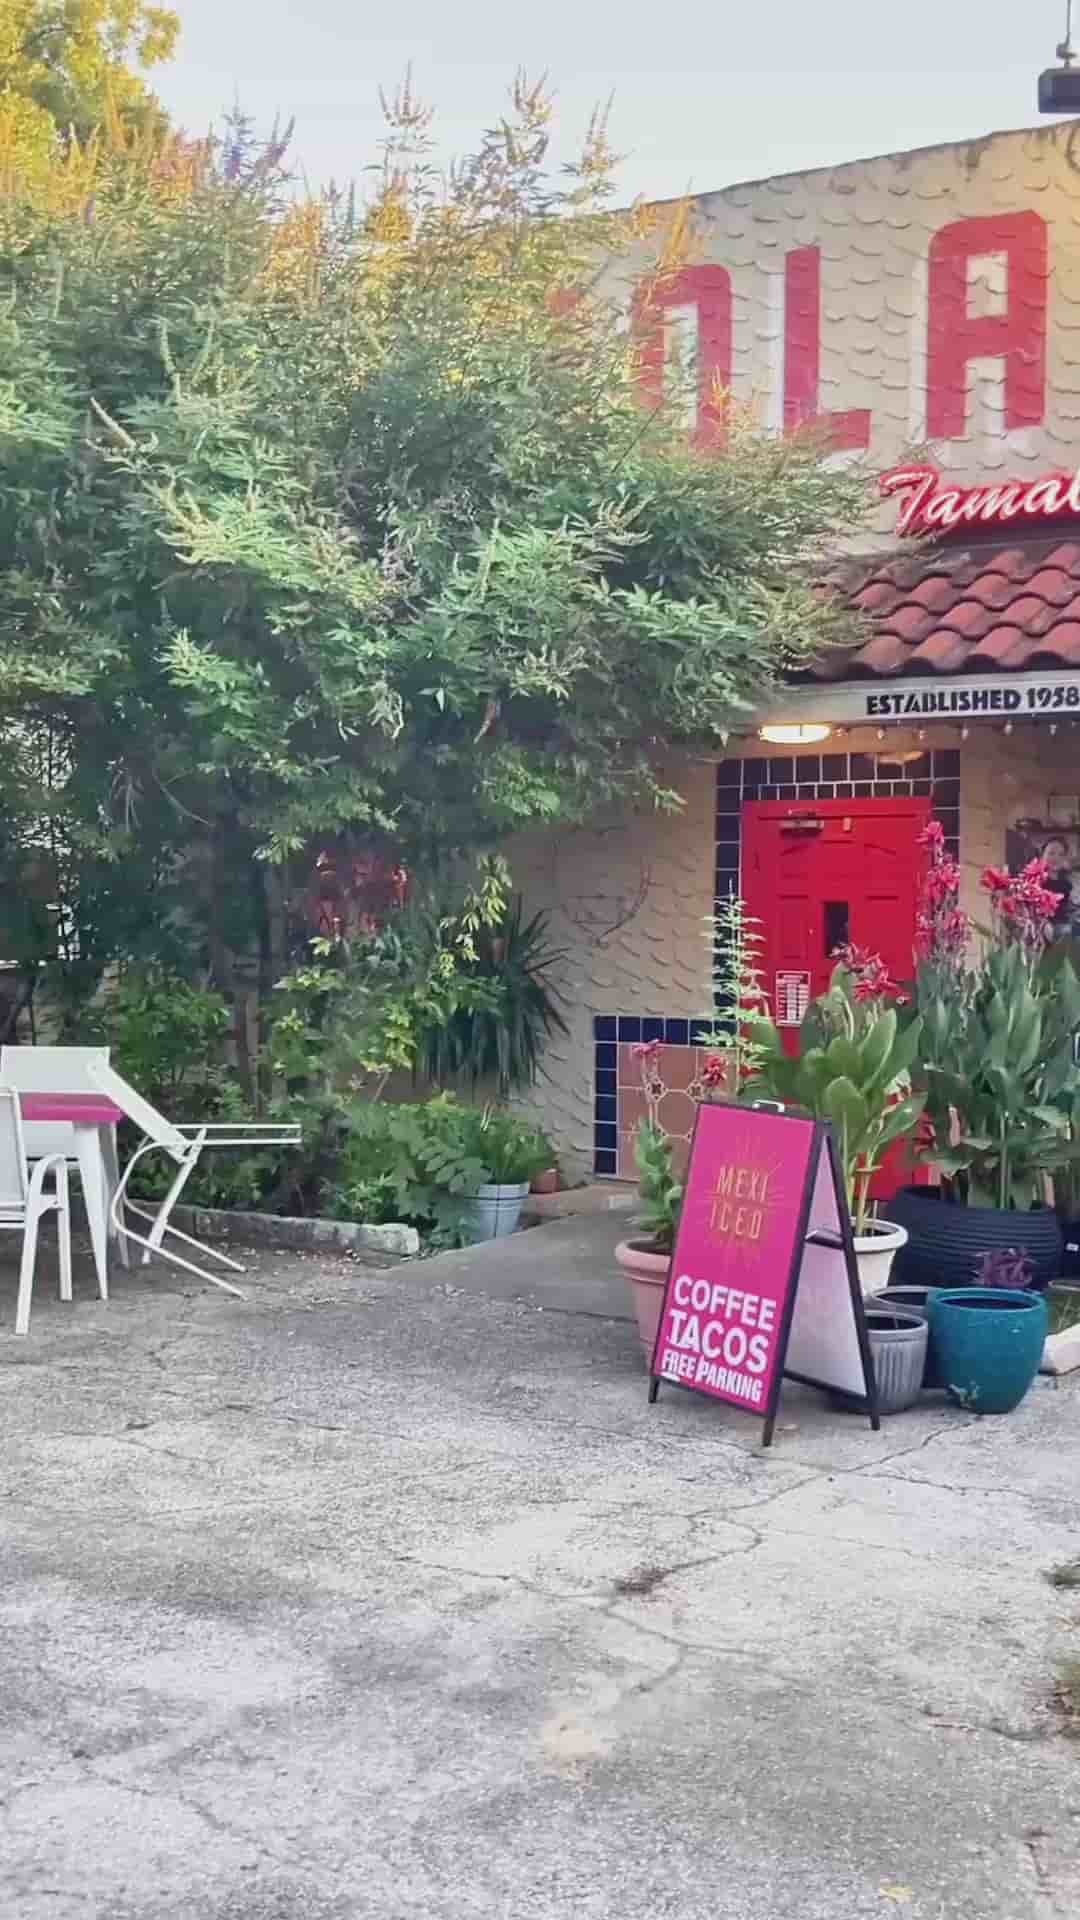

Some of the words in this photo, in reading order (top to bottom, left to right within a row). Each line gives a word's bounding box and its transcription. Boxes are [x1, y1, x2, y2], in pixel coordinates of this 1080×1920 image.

[545, 208, 1049, 455] OLA
[866, 688, 1021, 715] ESTABLISHED
[1026, 685, 1080, 709] 1958
[716, 1165, 769, 1201] MEXI
[674, 1274, 777, 1332] COFFEE
[666, 1308, 769, 1373] TACOS
[661, 1347, 697, 1379] FREE
[695, 1355, 763, 1403] PARKING
